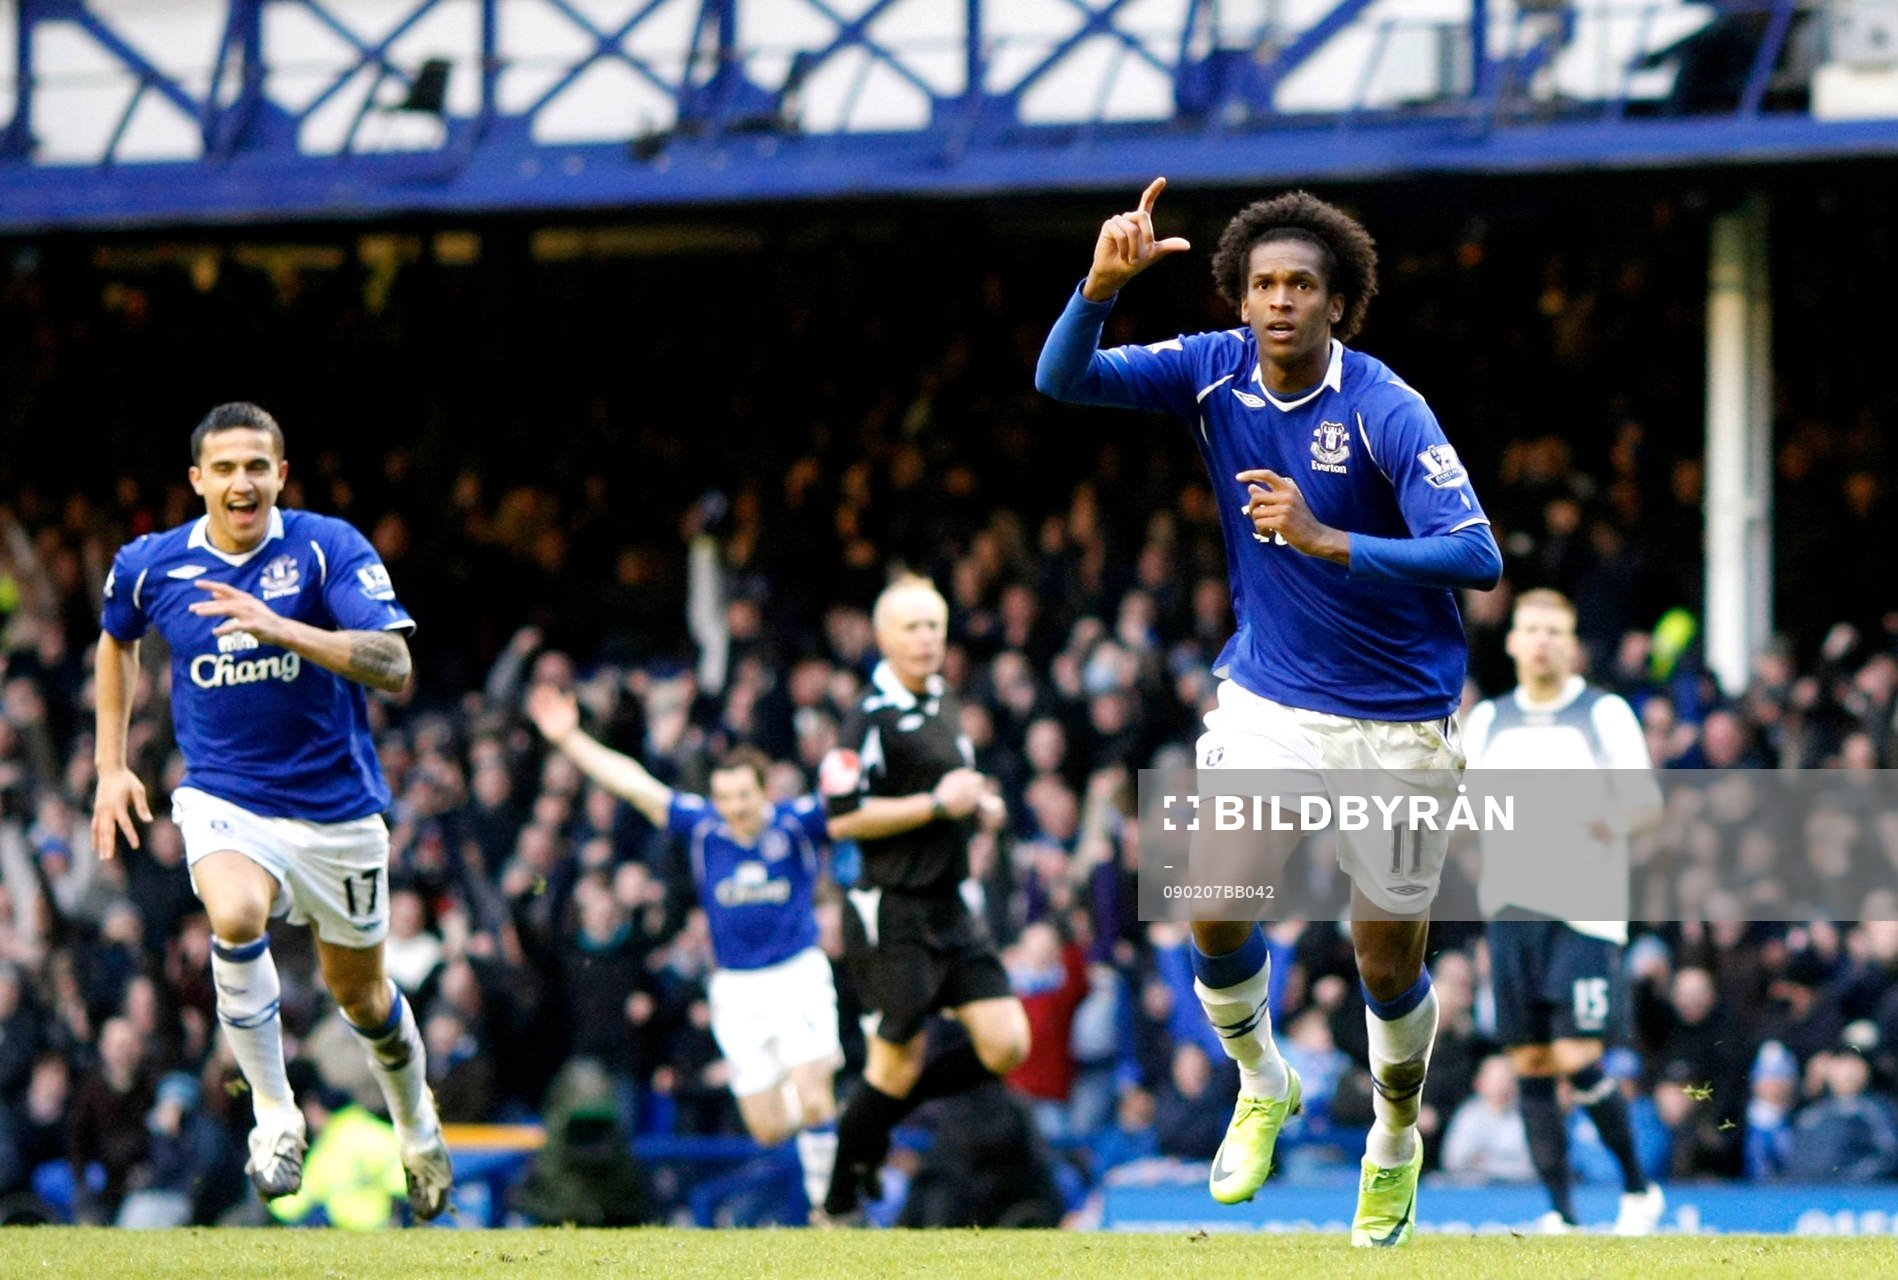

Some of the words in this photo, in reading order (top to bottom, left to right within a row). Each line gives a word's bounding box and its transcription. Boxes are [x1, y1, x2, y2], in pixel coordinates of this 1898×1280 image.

[1311, 459, 1347, 474] Everton
[190, 650, 301, 689] Chang
[1390, 820, 1422, 877] 11
[343, 867, 382, 917] 17
[1574, 977, 1609, 1019] 15
